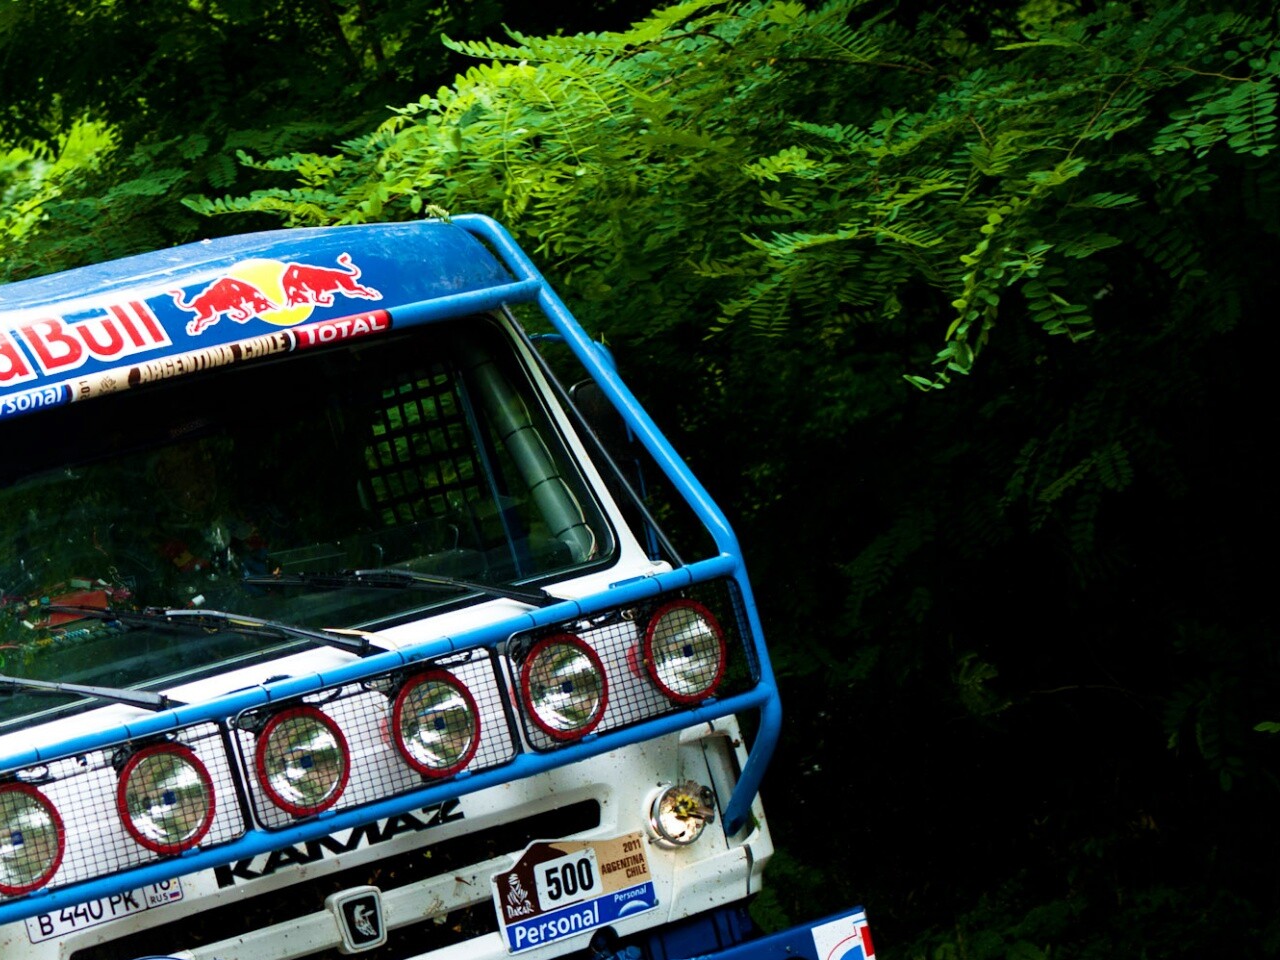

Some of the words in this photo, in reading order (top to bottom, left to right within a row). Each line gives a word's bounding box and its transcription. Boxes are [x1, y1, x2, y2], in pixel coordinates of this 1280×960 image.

[20, 299, 167, 371] Bull
[299, 315, 386, 345] TOTAL
[240, 333, 288, 361] CHILE
[213, 797, 466, 889] KAMAZ
[622, 838, 642, 853] 2011
[601, 852, 645, 876] ARGENTINA
[625, 863, 648, 879] CHILE
[545, 857, 595, 901] 500
[150, 893, 169, 904] RUS
[514, 901, 600, 949] Personal
[614, 884, 648, 903] Personal
